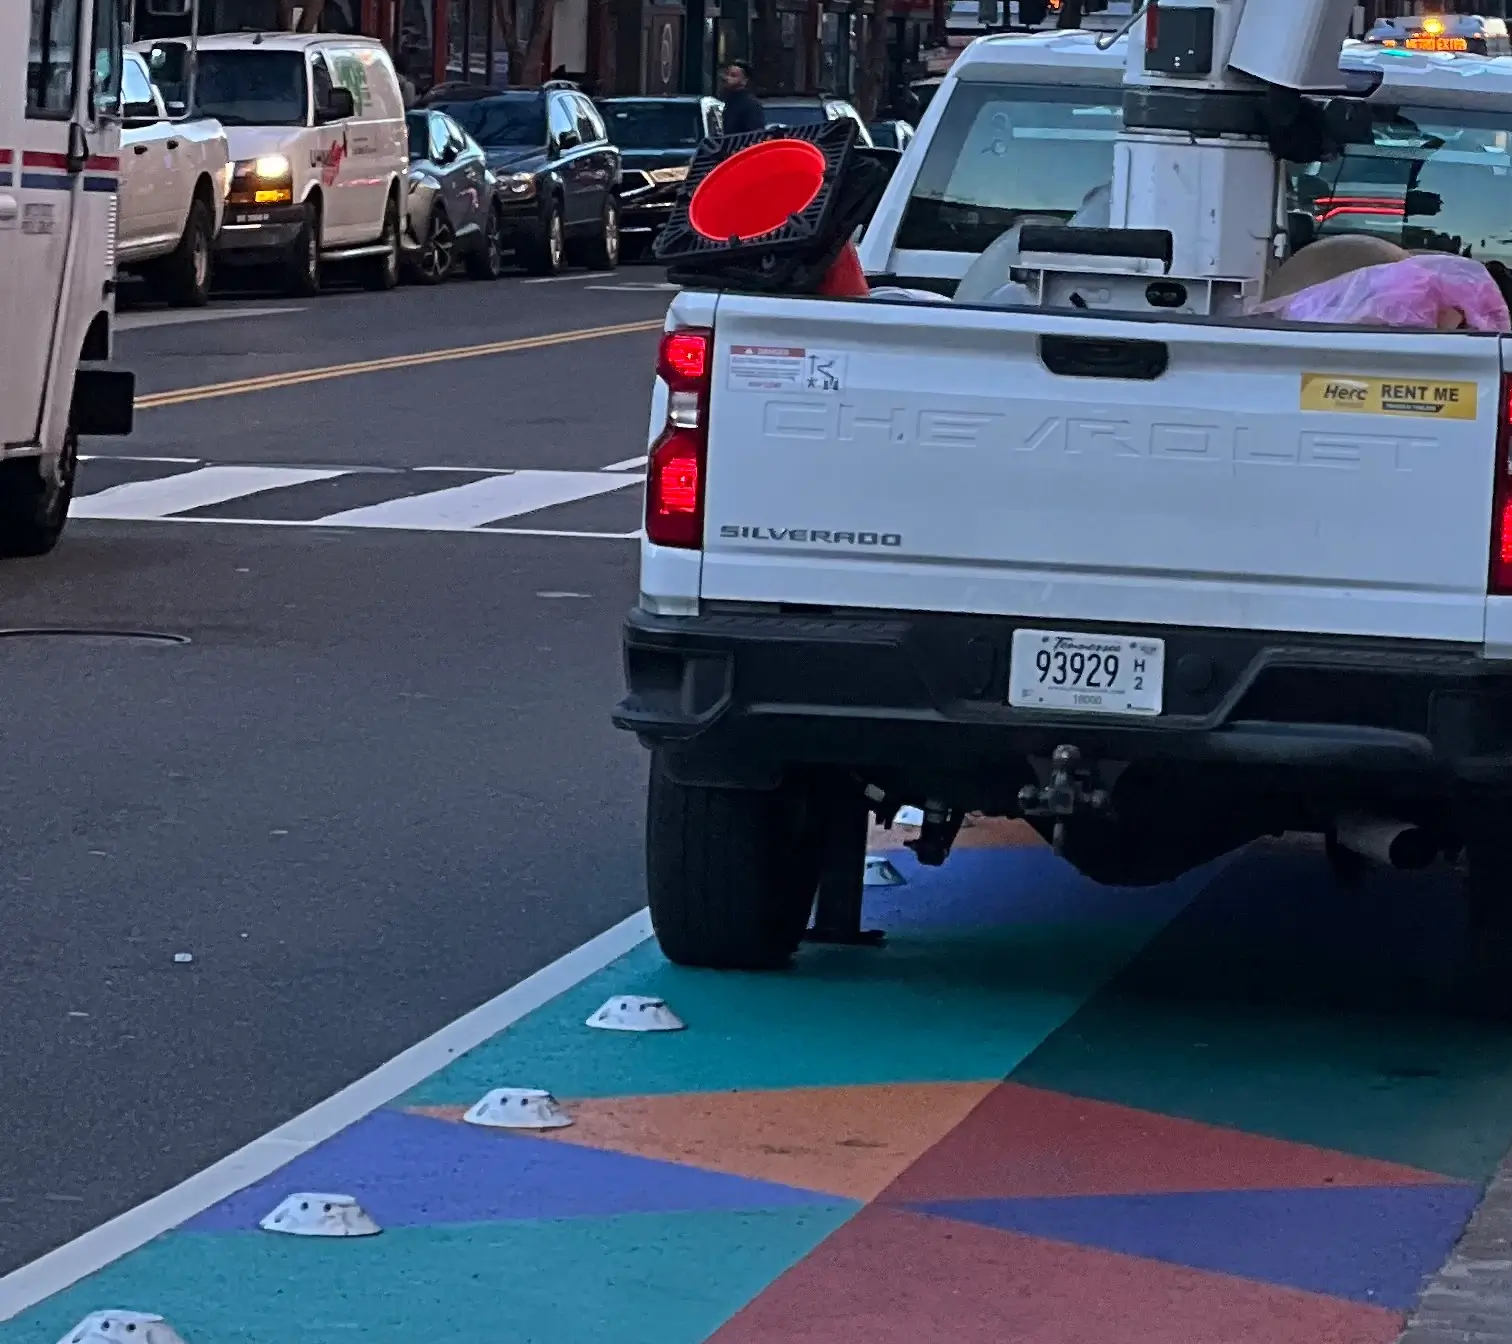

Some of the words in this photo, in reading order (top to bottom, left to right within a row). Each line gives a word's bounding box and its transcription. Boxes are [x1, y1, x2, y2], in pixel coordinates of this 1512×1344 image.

[1323, 384, 1369, 401] Herc
[1381, 384, 1429, 401] RENT
[1433, 387, 1460, 403] ME
[720, 524, 902, 547] SILVERADO
[1036, 650, 1119, 688] 93929
[1133, 659, 1146, 673] H
[1133, 676, 1144, 690] 2
